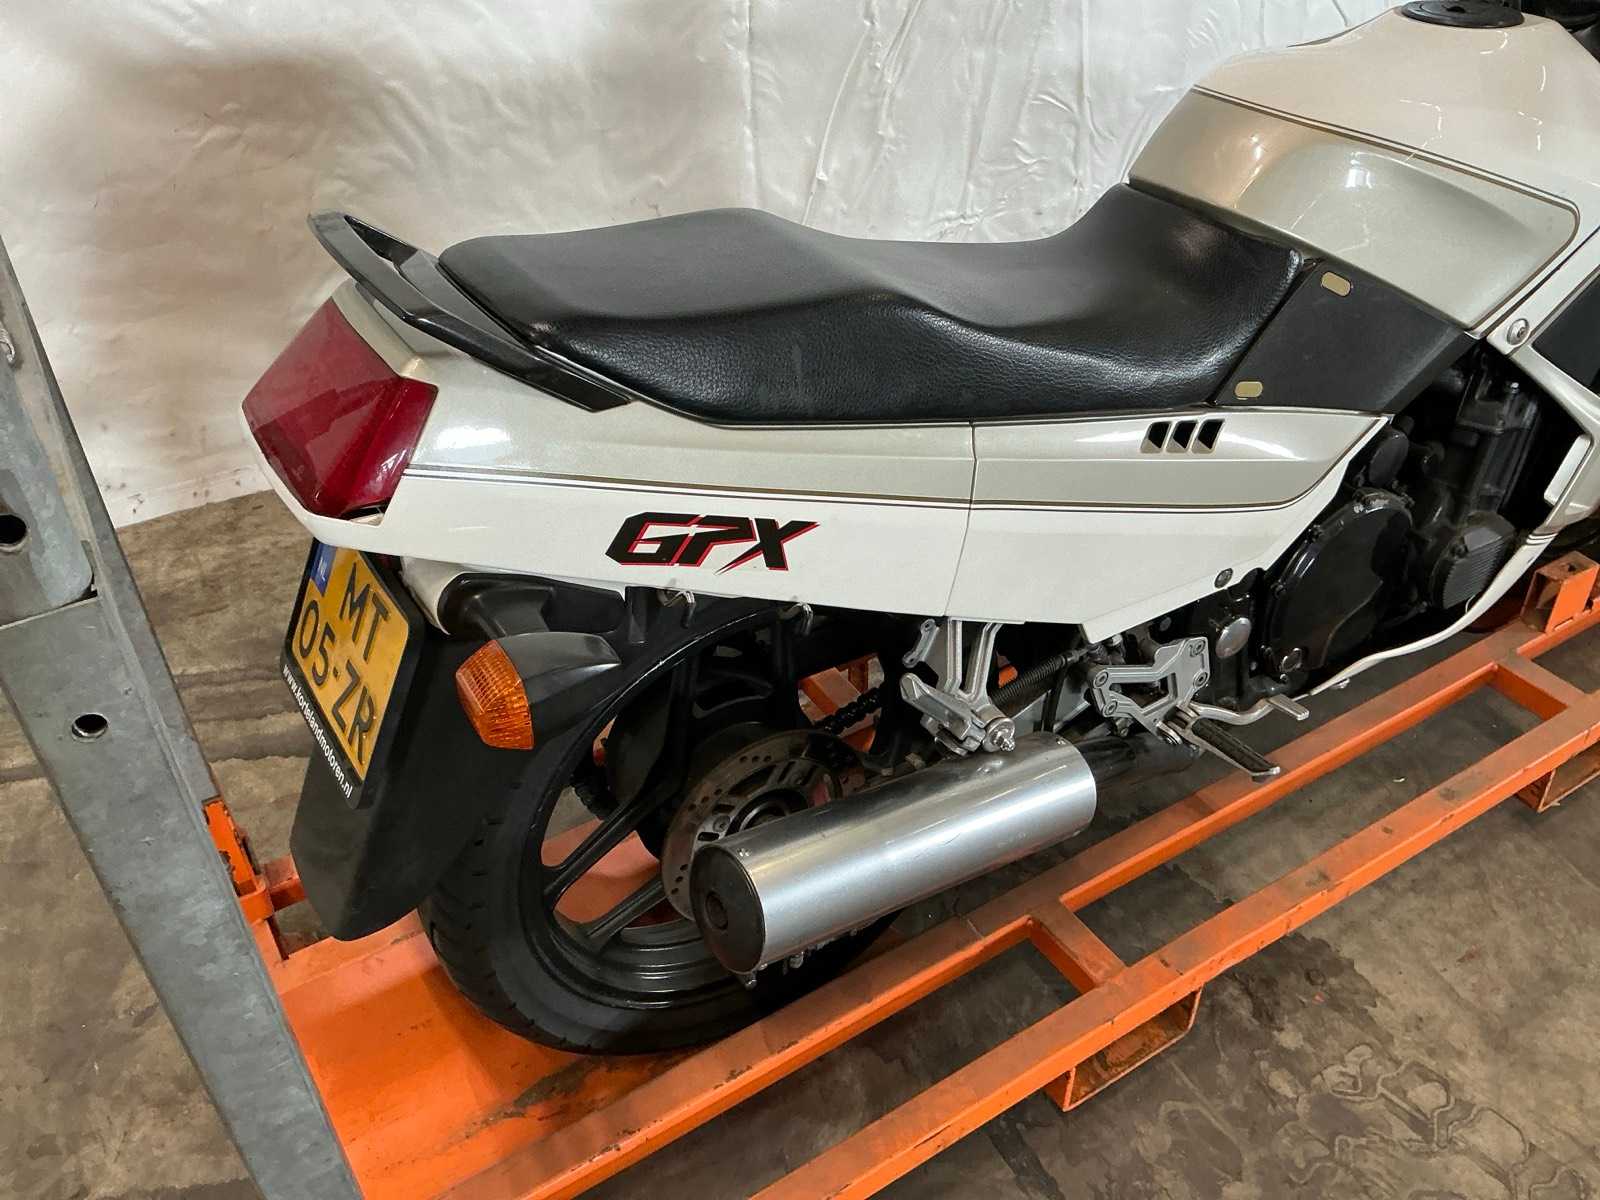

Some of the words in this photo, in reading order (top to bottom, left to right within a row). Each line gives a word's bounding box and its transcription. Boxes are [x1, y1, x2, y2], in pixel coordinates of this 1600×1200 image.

[605, 511, 821, 575] GPX
[339, 562, 389, 663] MT
[282, 664, 353, 799] www.kortelandmotoren.nl
